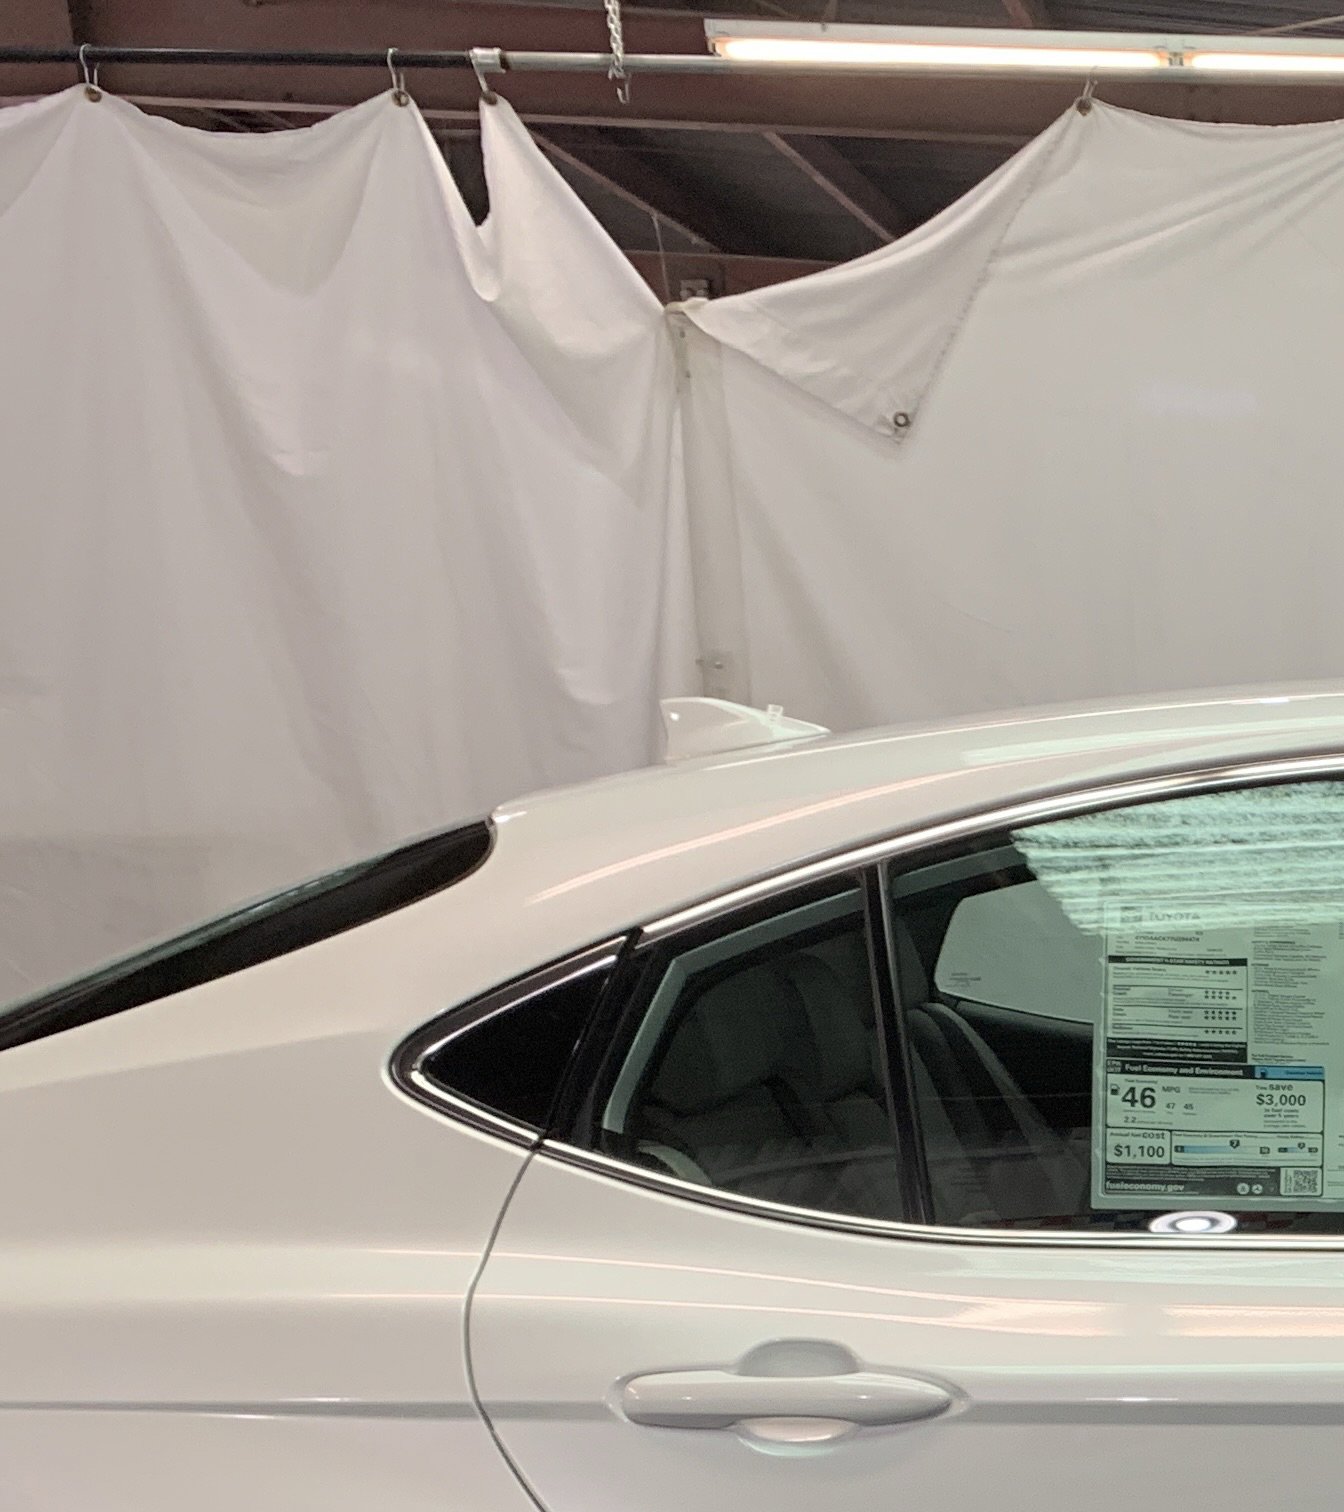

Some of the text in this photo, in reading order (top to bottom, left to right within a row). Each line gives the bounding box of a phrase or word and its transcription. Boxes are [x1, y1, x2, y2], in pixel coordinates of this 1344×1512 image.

[1125, 1063, 1141, 1072] Fuel
[1142, 1064, 1178, 1074] Economy
[1178, 1066, 1194, 1074] and
[1194, 1066, 1243, 1076] Environment
[1162, 1085, 1181, 1093] MPG
[1268, 1083, 1294, 1091] save
[1121, 1086, 1156, 1109] 46
[1255, 1093, 1307, 1107] $3,000
[1165, 1102, 1176, 1110] 47
[1142, 1131, 1166, 1140] cost
[1113, 1143, 1165, 1158] $1,100
[1105, 1181, 1184, 1192] fueleconomy.gov
